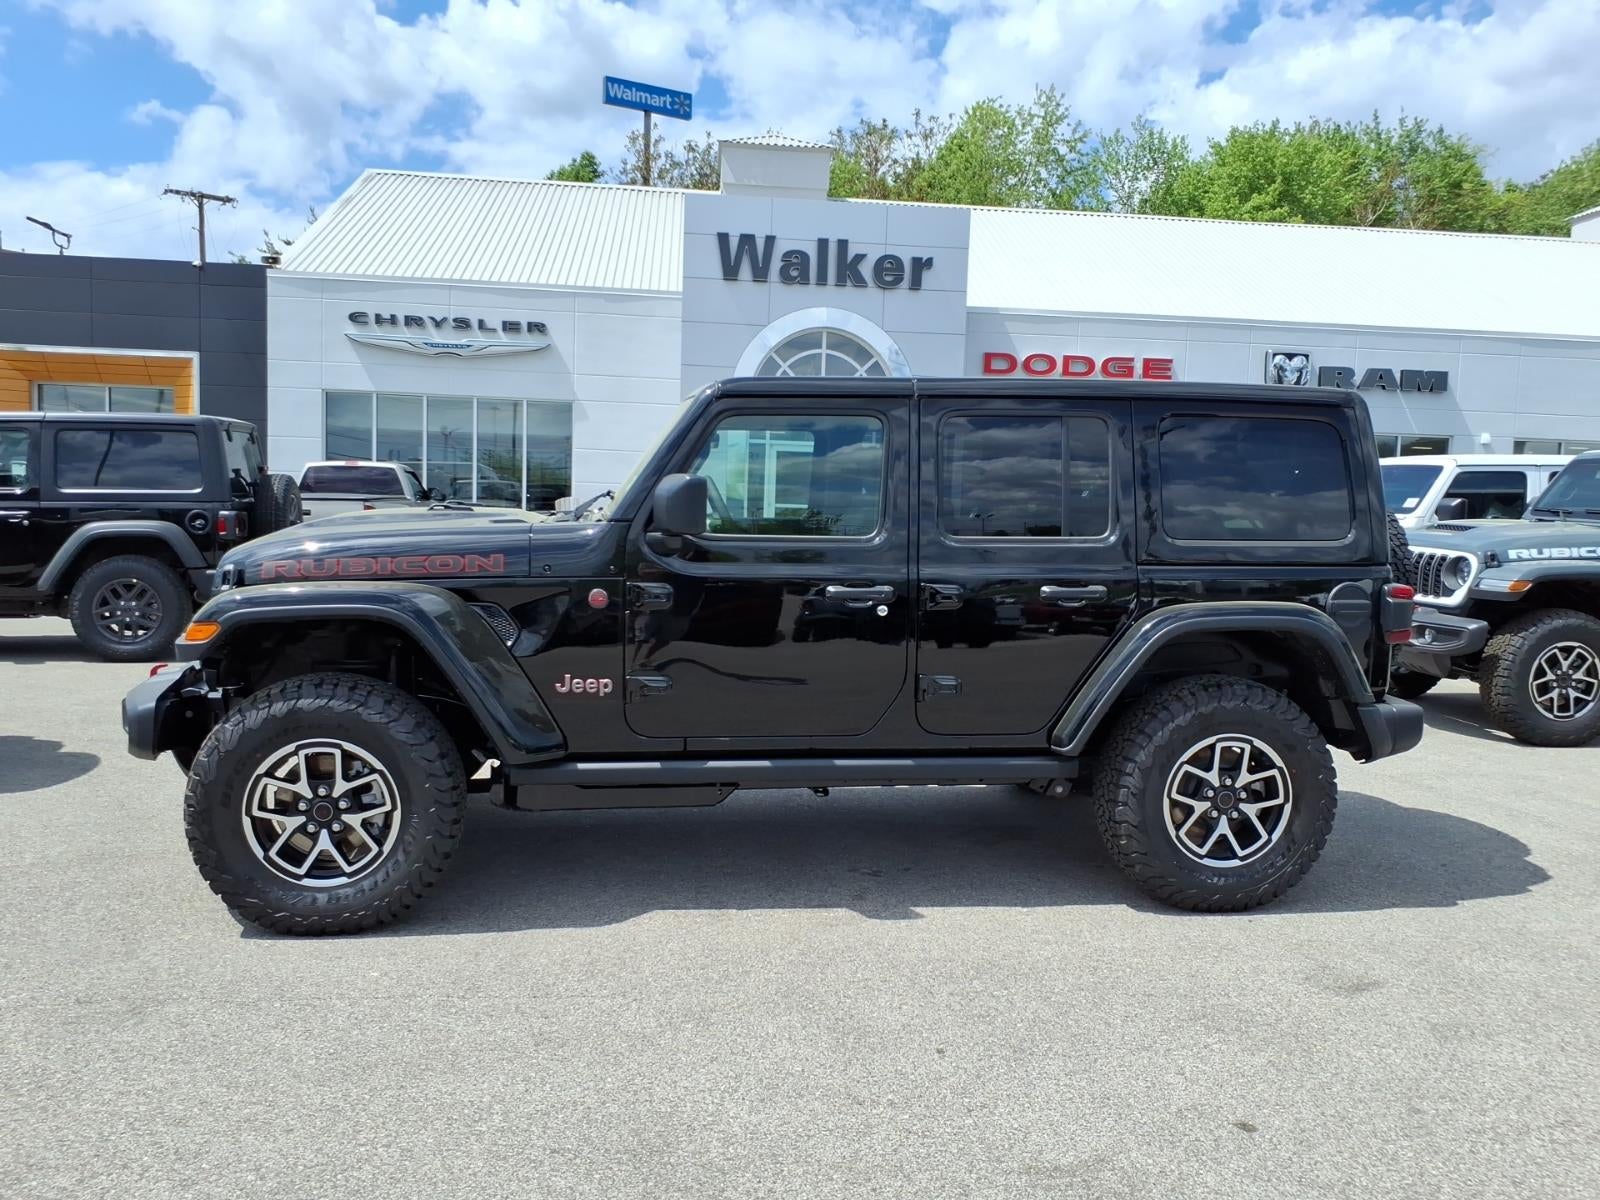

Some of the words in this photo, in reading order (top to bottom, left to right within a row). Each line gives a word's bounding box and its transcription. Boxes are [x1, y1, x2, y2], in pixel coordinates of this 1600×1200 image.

[608, 81, 672, 110] Walmart
[717, 233, 933, 290] Walker
[348, 311, 548, 335] CHRYSLER
[982, 352, 1173, 381] DODGE
[1318, 366, 1449, 393] RAM
[261, 553, 505, 579] RUBICON
[1507, 547, 1600, 560] RUBIC
[554, 673, 613, 697] Jeep
